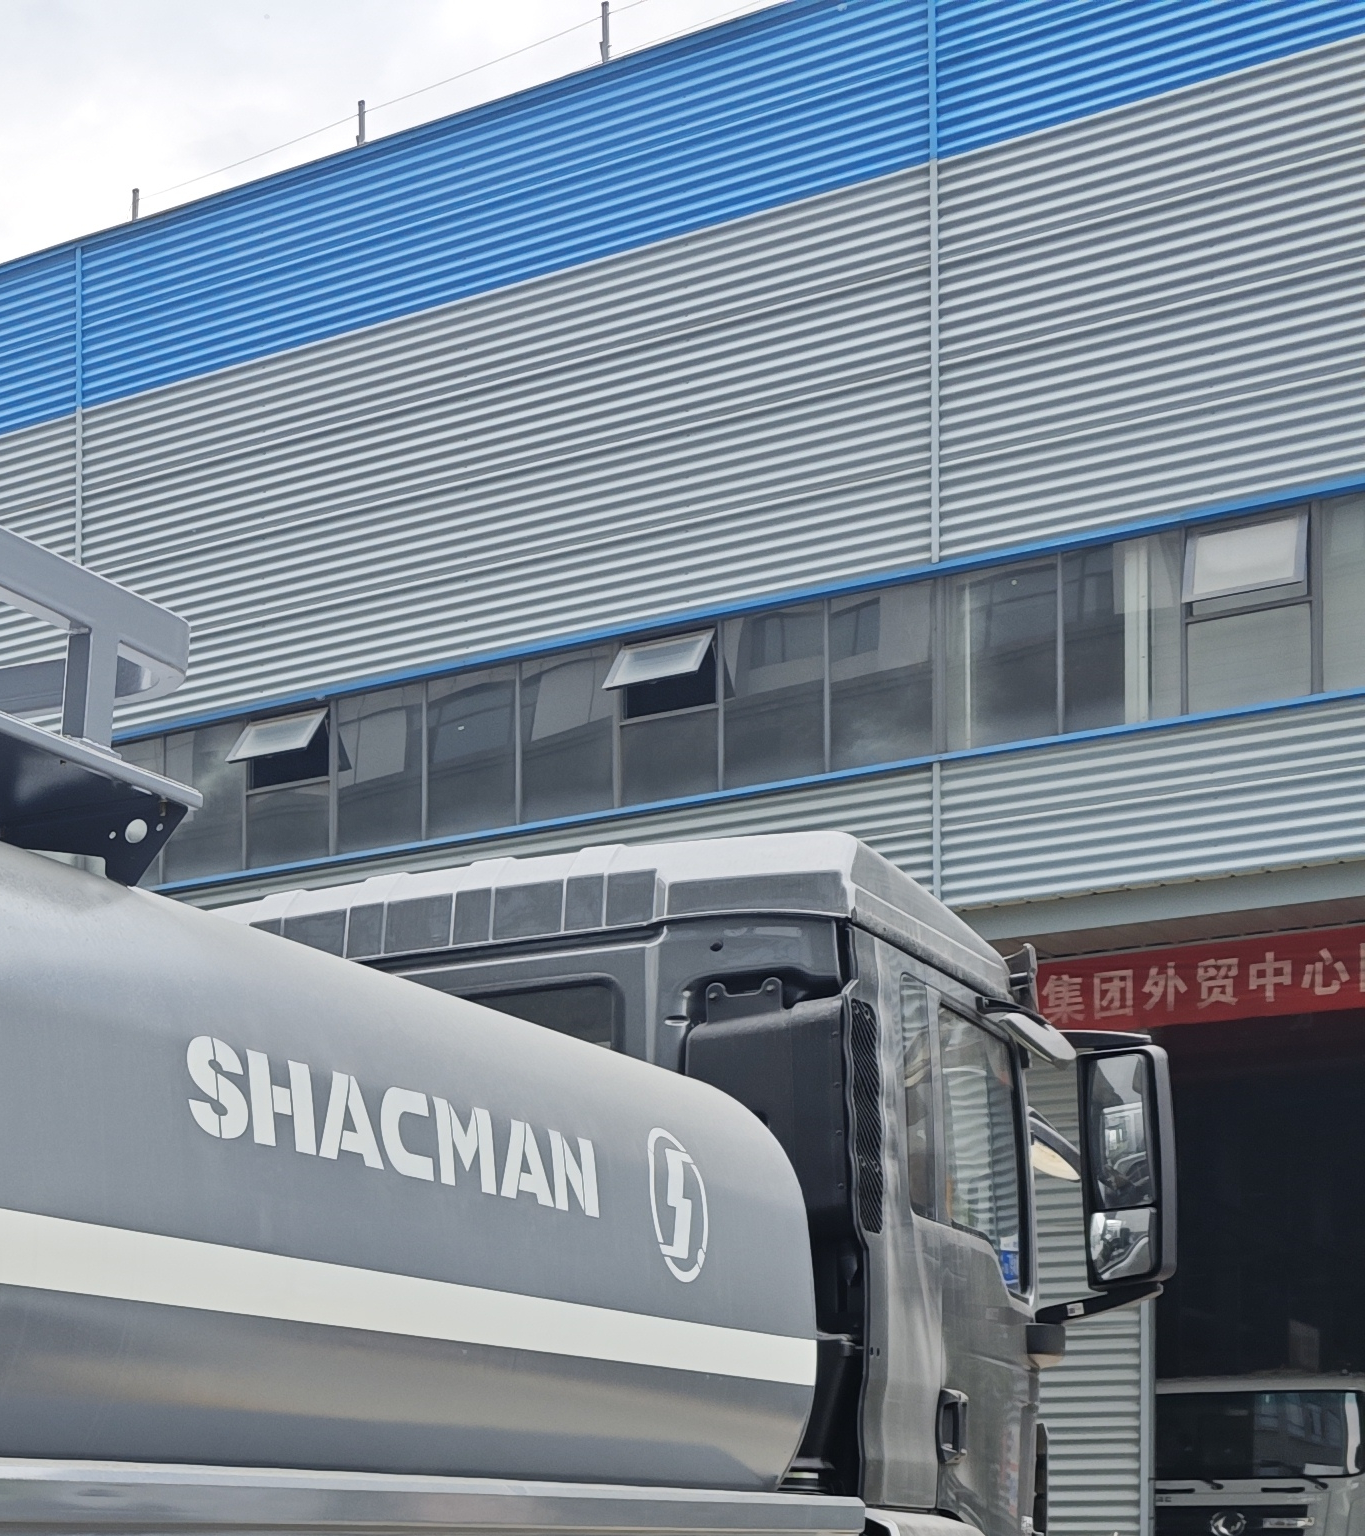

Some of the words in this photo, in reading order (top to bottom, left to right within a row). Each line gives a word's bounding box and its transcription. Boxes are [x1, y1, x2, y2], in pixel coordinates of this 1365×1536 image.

[1041, 943, 1365, 1025] 集团外贸中心
[185, 1035, 600, 1219] SHACMAN
